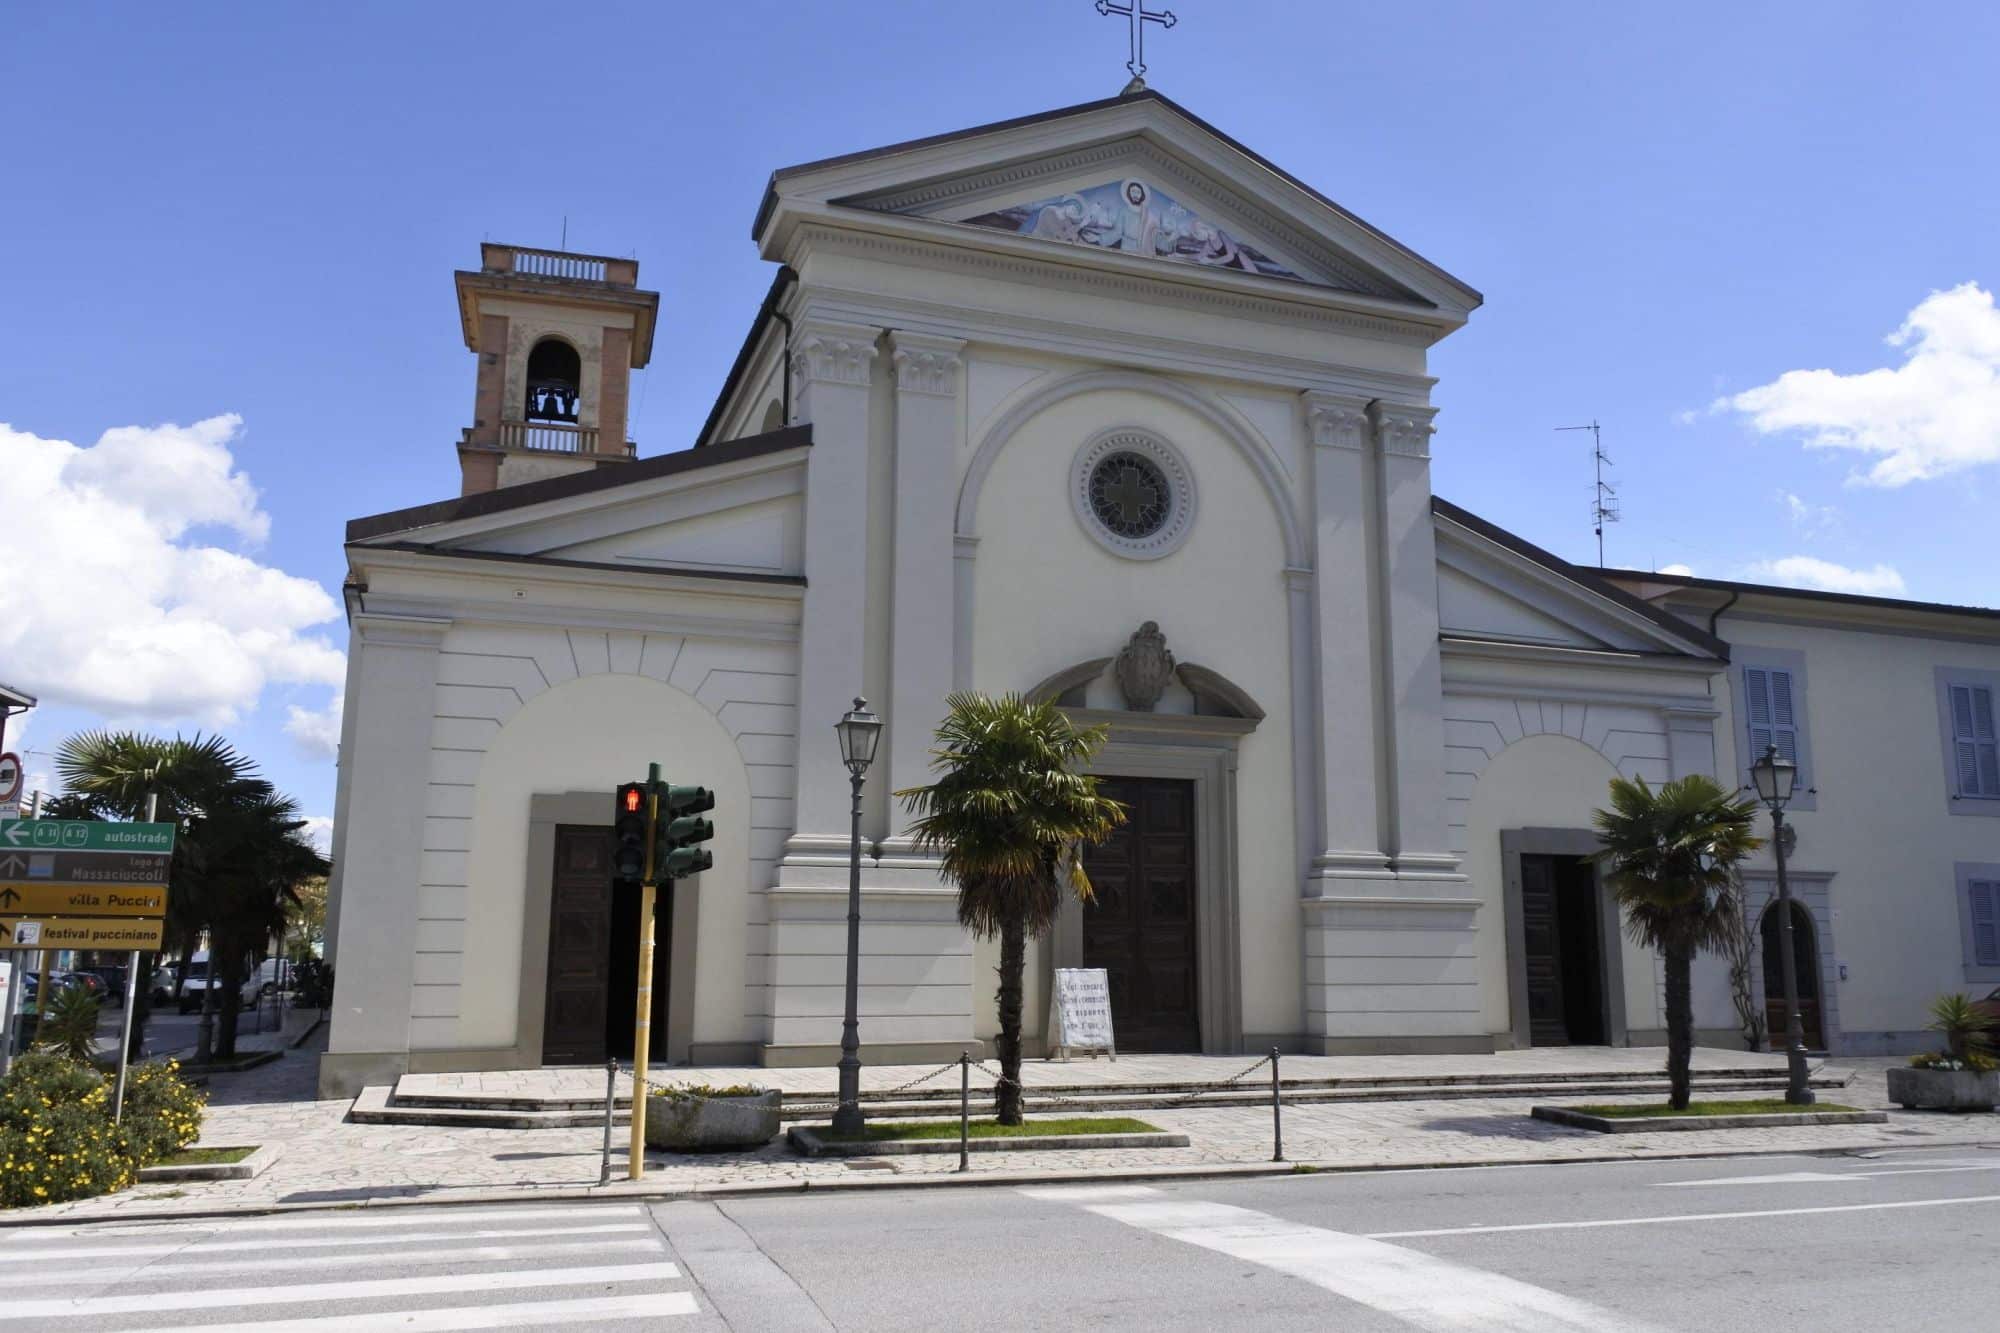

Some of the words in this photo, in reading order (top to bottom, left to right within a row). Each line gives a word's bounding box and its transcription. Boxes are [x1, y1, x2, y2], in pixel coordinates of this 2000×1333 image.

[104, 831, 168, 843] autostrade
[154, 857, 165, 867] di
[72, 868, 164, 881] Massaciuccoli
[69, 893, 100, 906] villa
[108, 894, 161, 908] Puccini
[44, 927, 89, 939] festival
[92, 928, 158, 941] pucciniano
